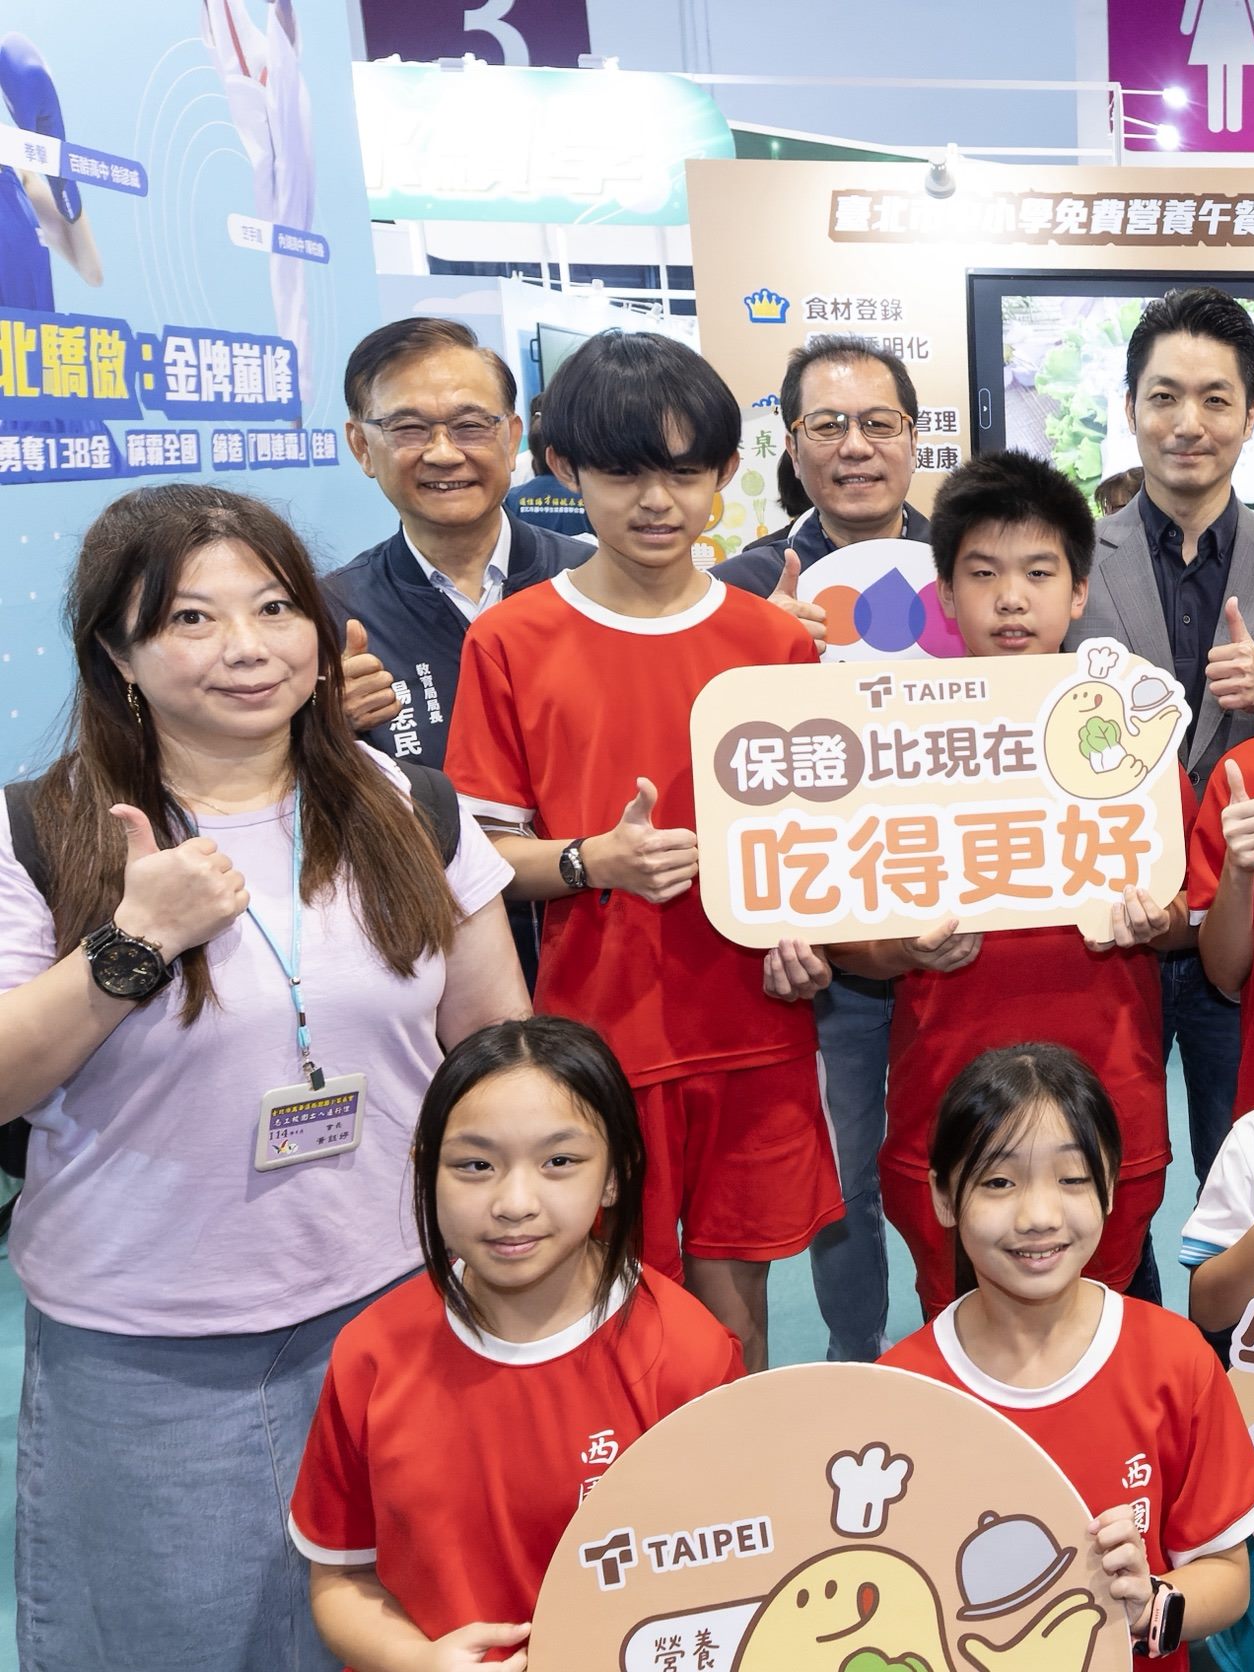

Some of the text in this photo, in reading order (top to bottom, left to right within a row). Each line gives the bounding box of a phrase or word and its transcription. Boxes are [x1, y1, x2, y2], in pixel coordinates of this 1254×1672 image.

[805, 296, 903, 321] 食材登錄
[415, 662, 443, 724] 教育局局長
[903, 680, 987, 702] TAIPEI
[730, 724, 1037, 792] 保證比現在
[740, 804, 1152, 915] 吃得更好
[269, 1128, 288, 1141] 114
[647, 1521, 771, 1568] TAIPEI
[654, 1628, 720, 1672] 營養
